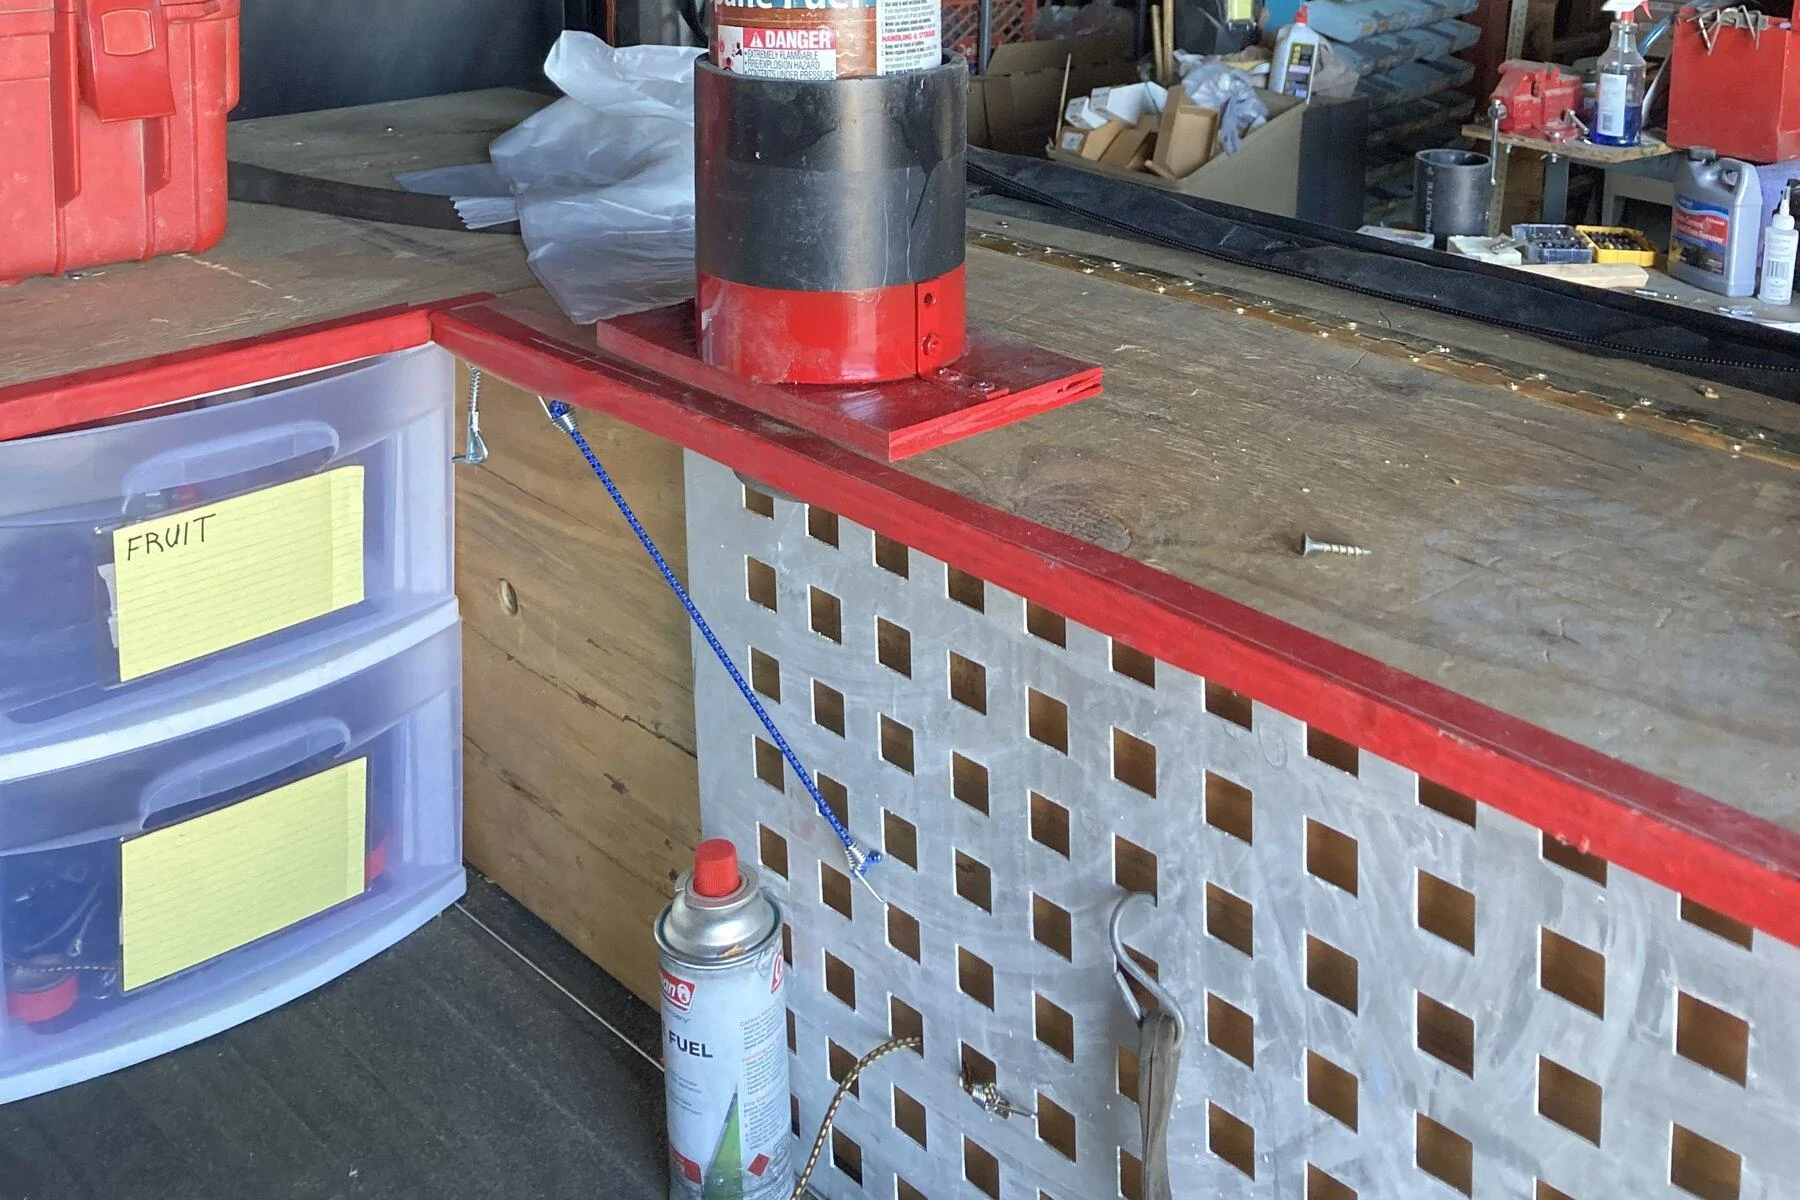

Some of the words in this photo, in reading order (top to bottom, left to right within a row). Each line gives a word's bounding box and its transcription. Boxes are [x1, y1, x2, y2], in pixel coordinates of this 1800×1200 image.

[765, 29, 832, 49] DANGER
[747, 50, 779, 60] EXTREMELY
[793, 60, 820, 69] HAZARD
[127, 513, 216, 561] FRUIT
[668, 1030, 714, 1059] FUEL
